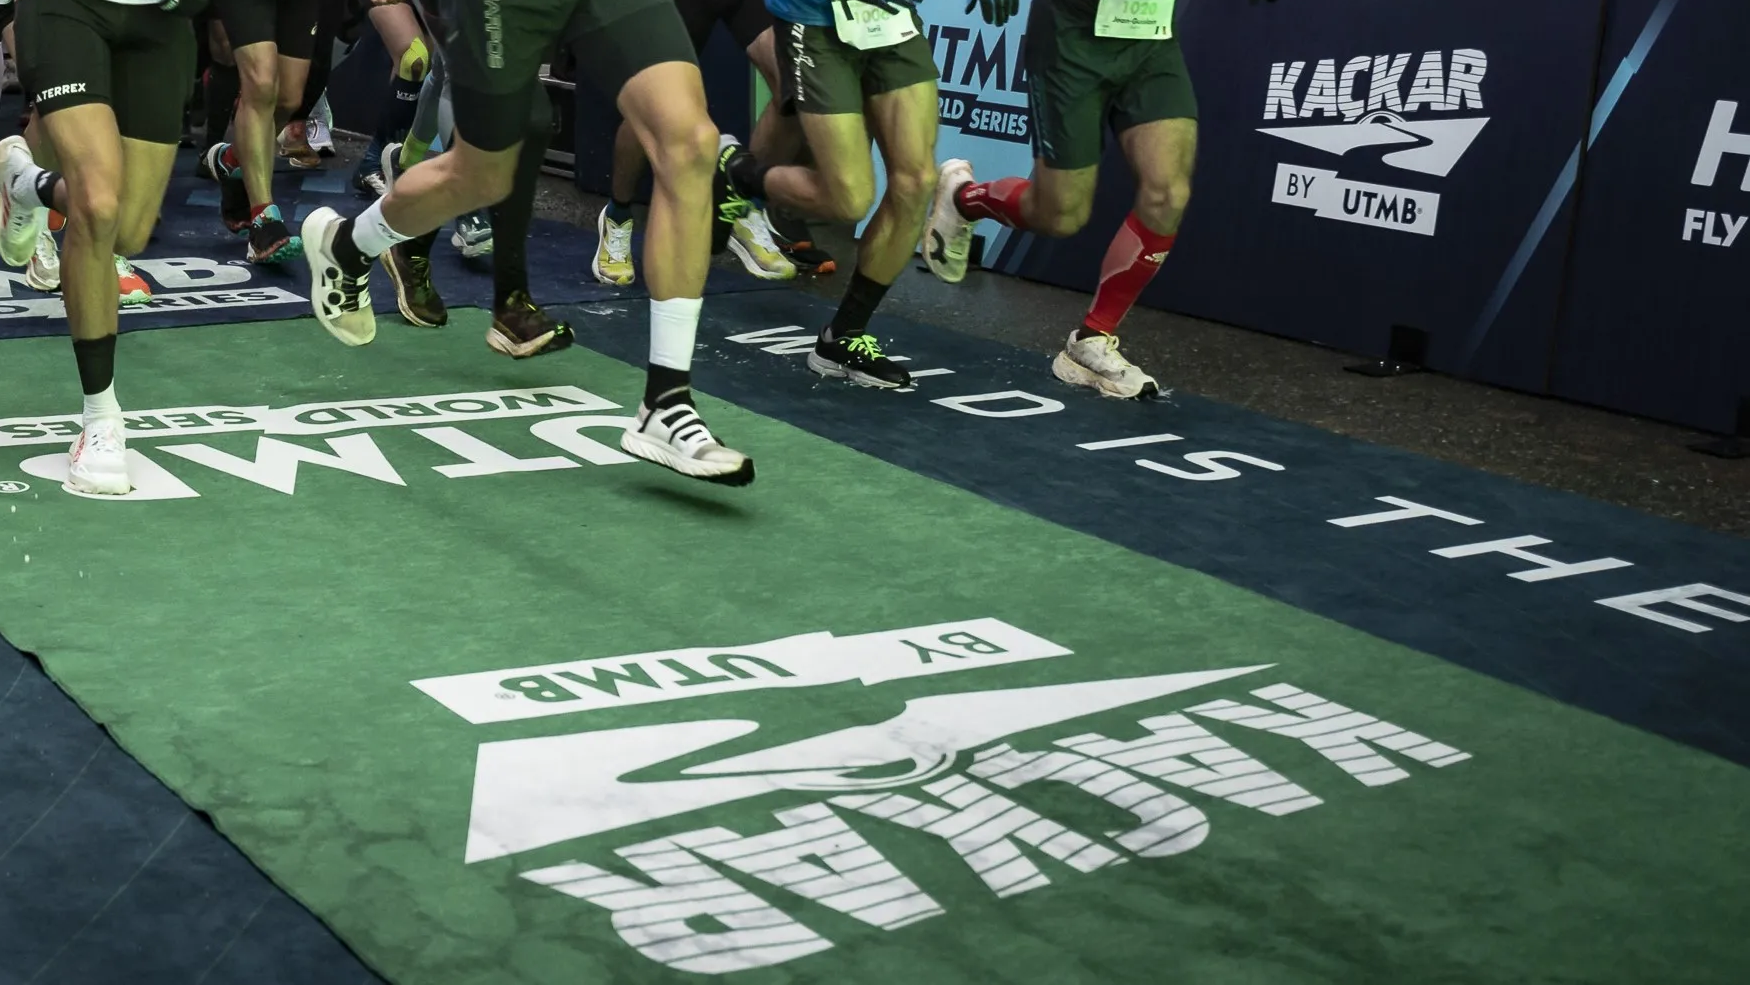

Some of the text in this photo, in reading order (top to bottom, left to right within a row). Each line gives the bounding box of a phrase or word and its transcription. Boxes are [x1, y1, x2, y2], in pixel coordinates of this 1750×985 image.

[1122, 0, 1158, 16] 1020
[41, 82, 87, 100] TERREX
[1263, 48, 1488, 122] KAÇKAR
[969, 107, 1029, 136] SERIES
[1286, 173, 1417, 225] BY UTMB
[1682, 208, 1749, 247] FLY
[294, 391, 584, 428] WORLD
[1075, 433, 1286, 482] IS
[1326, 495, 1750, 634] THE
[500, 630, 1009, 704] BY UTMB
